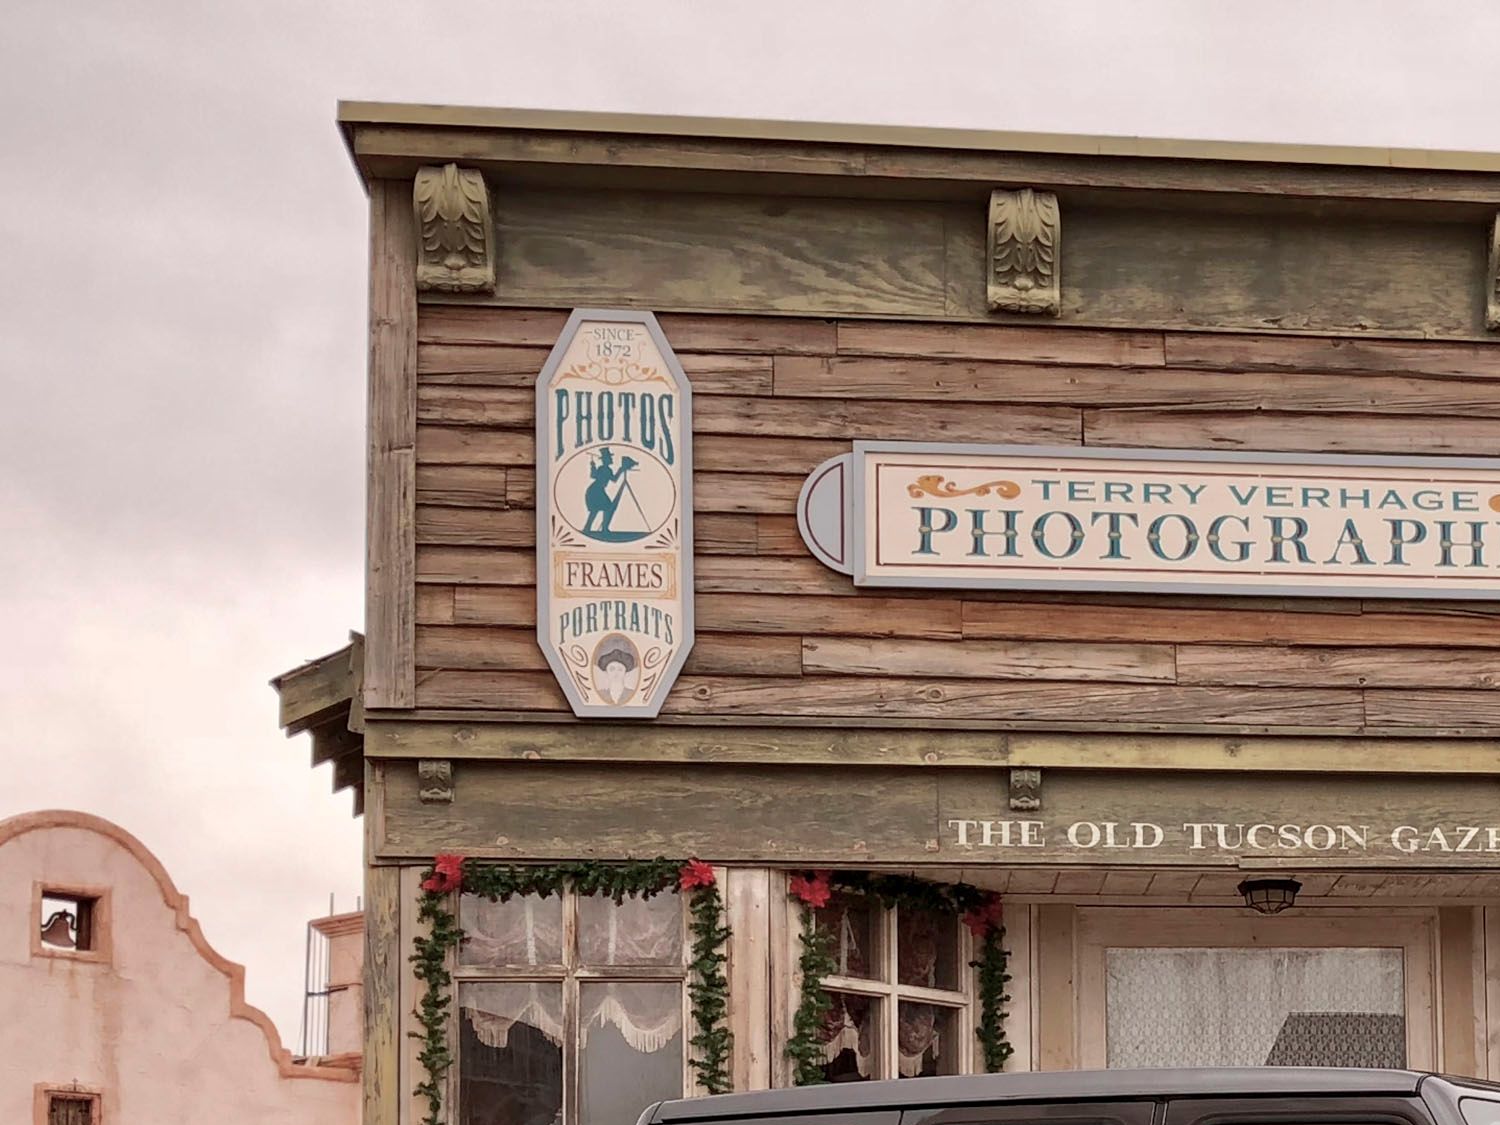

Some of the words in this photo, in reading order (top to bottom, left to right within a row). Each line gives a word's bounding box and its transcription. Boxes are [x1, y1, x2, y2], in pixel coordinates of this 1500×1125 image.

[593, 327, 636, 342] SINCE
[596, 343, 632, 358] 1872
[555, 388, 675, 466] PHOTOS
[1031, 479, 1207, 504] TERRY
[1228, 485, 1480, 512] VERHAGE
[566, 561, 663, 589] FRAMES
[559, 600, 674, 645] PORTRAITS
[948, 819, 1045, 848] THE
[1067, 821, 1165, 849] OLD
[1183, 822, 1369, 851] TUCSON
